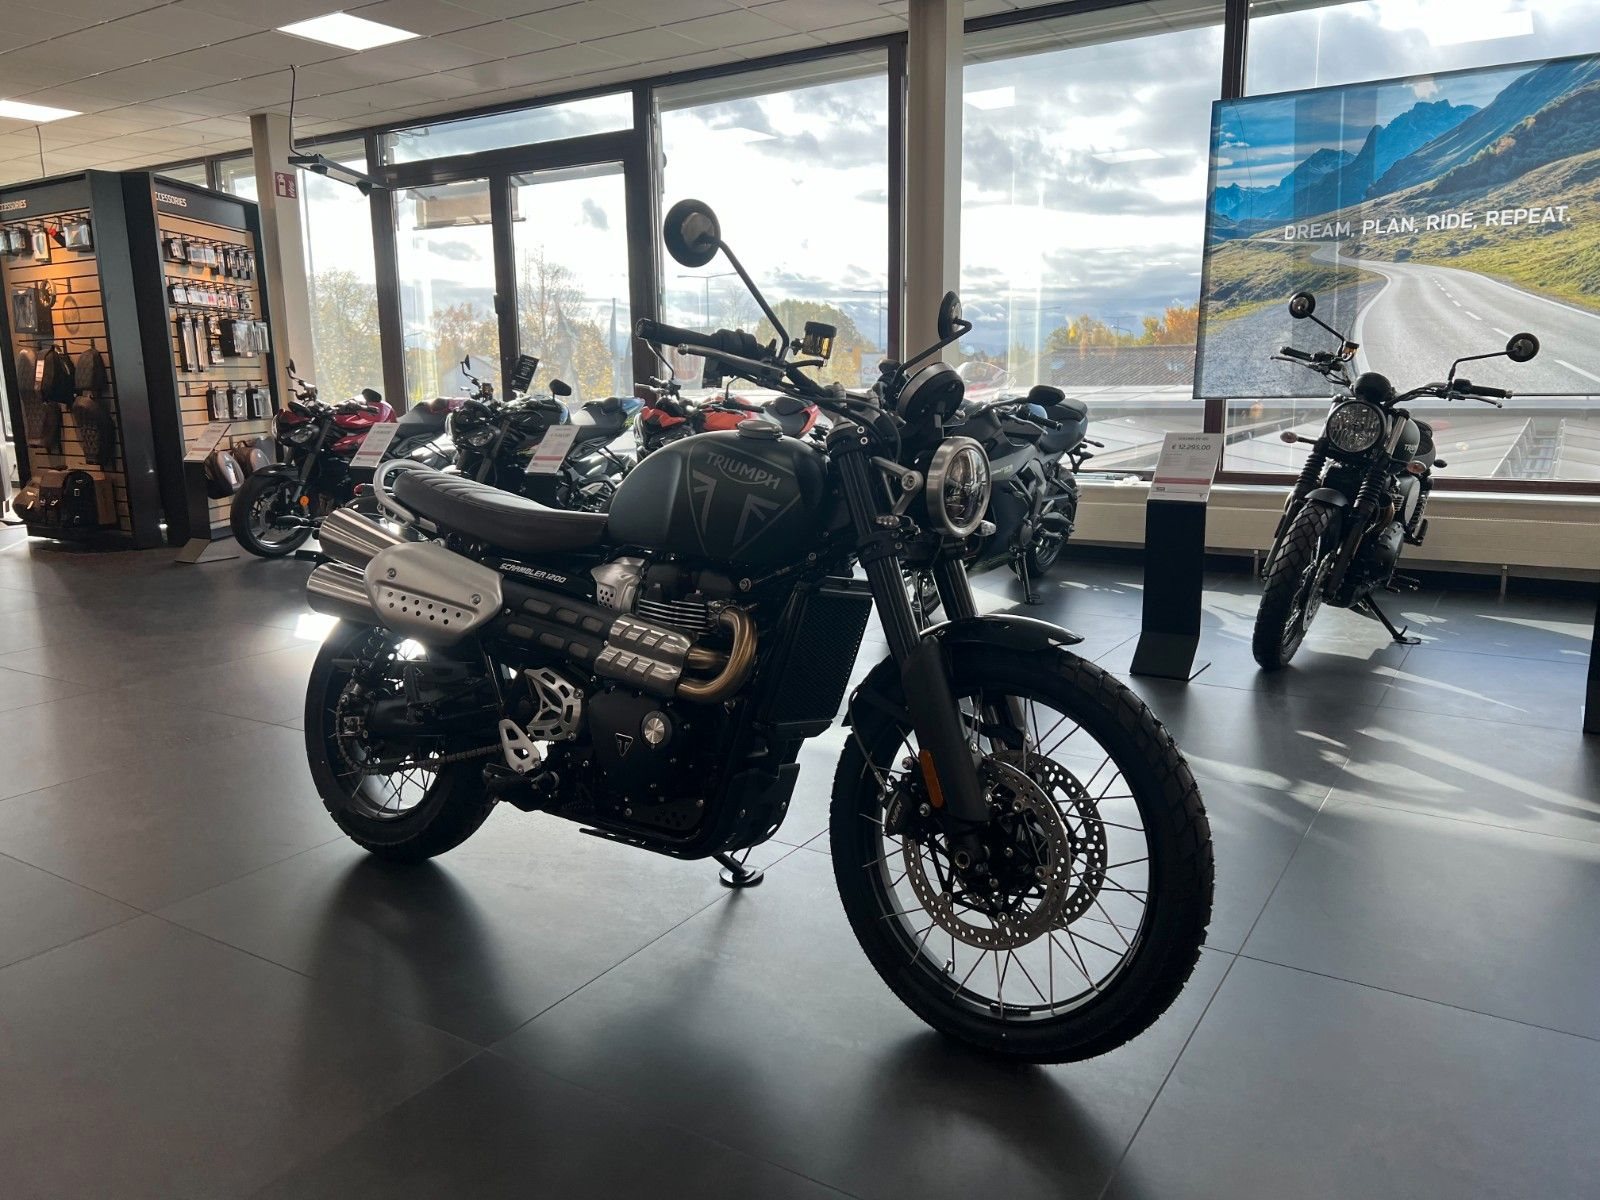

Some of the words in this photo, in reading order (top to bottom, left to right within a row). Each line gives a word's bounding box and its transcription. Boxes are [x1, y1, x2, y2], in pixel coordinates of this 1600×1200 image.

[1284, 221, 1354, 241] DREAM,
[1362, 216, 1419, 235] PLAN,
[1426, 212, 1478, 231] RIDE,
[1485, 205, 1571, 227] REPEAT.
[706, 451, 782, 490] TRIUMPH
[499, 562, 547, 579] SCRAMBLER
[545, 573, 567, 584] 1200
